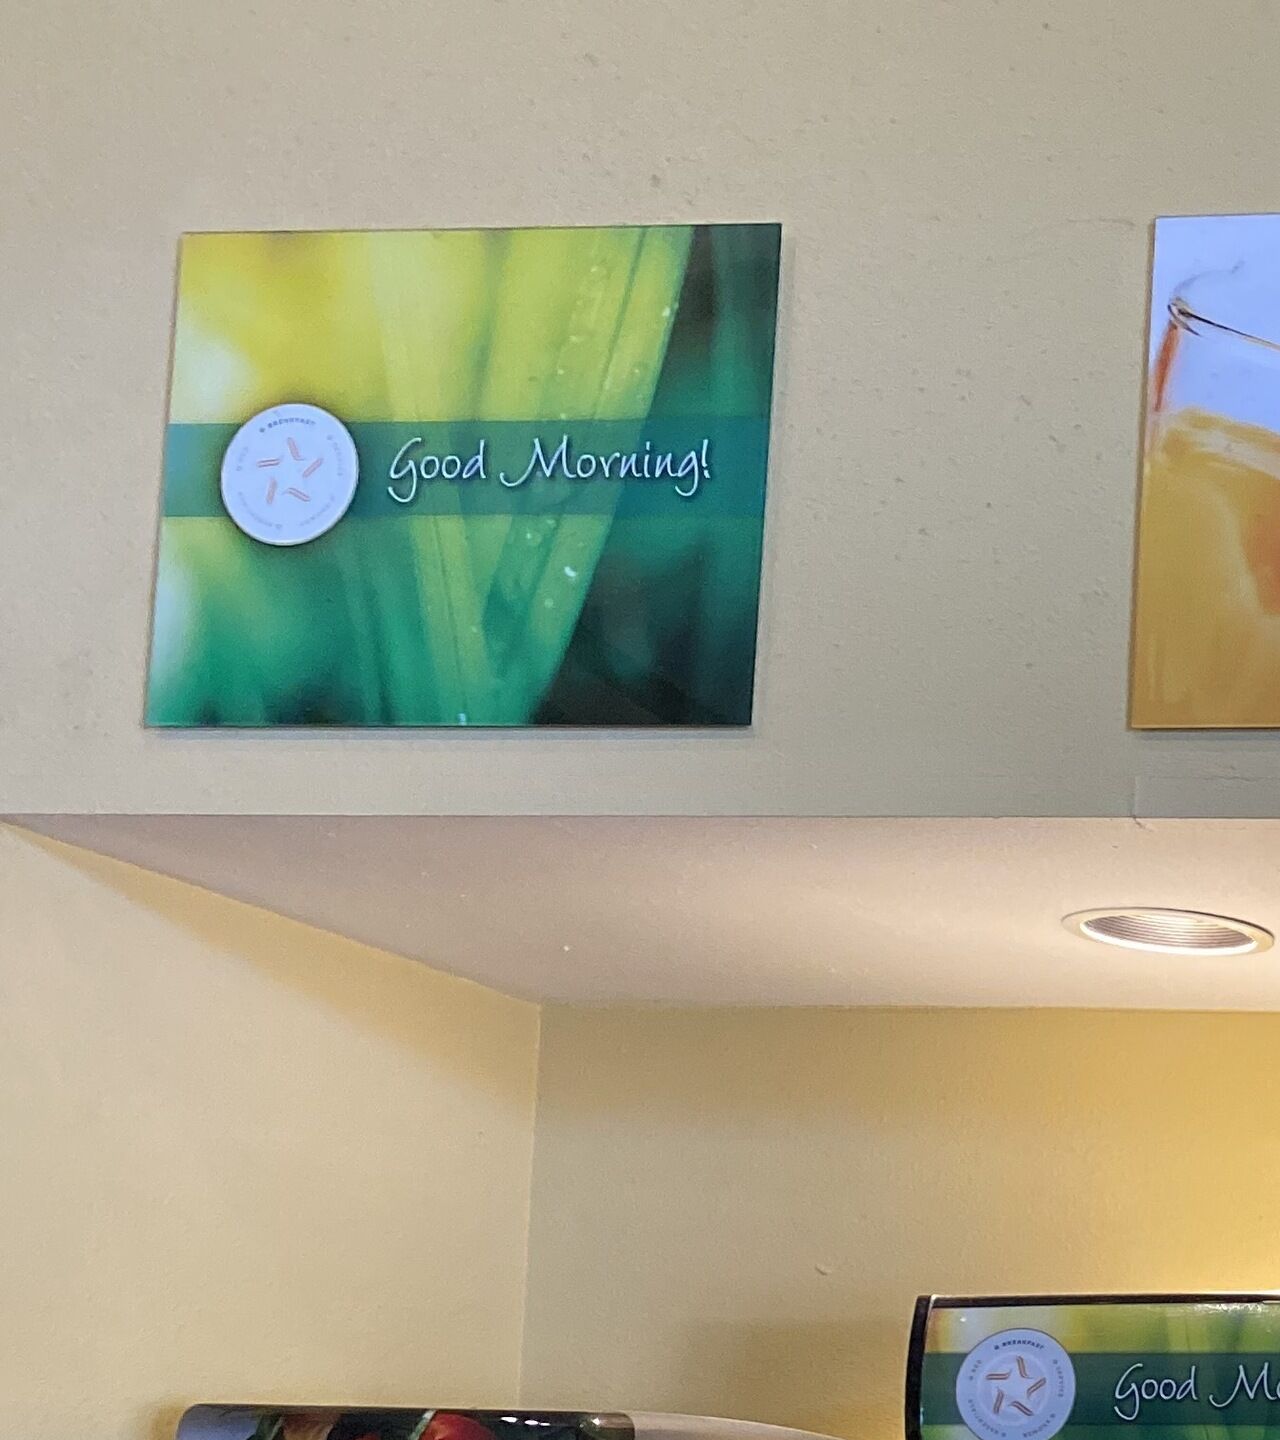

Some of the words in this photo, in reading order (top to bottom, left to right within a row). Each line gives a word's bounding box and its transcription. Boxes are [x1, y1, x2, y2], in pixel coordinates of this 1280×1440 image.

[387, 436, 487, 503] Good
[499, 432, 711, 498] Morning!
[1113, 1362, 1198, 1421] Good
